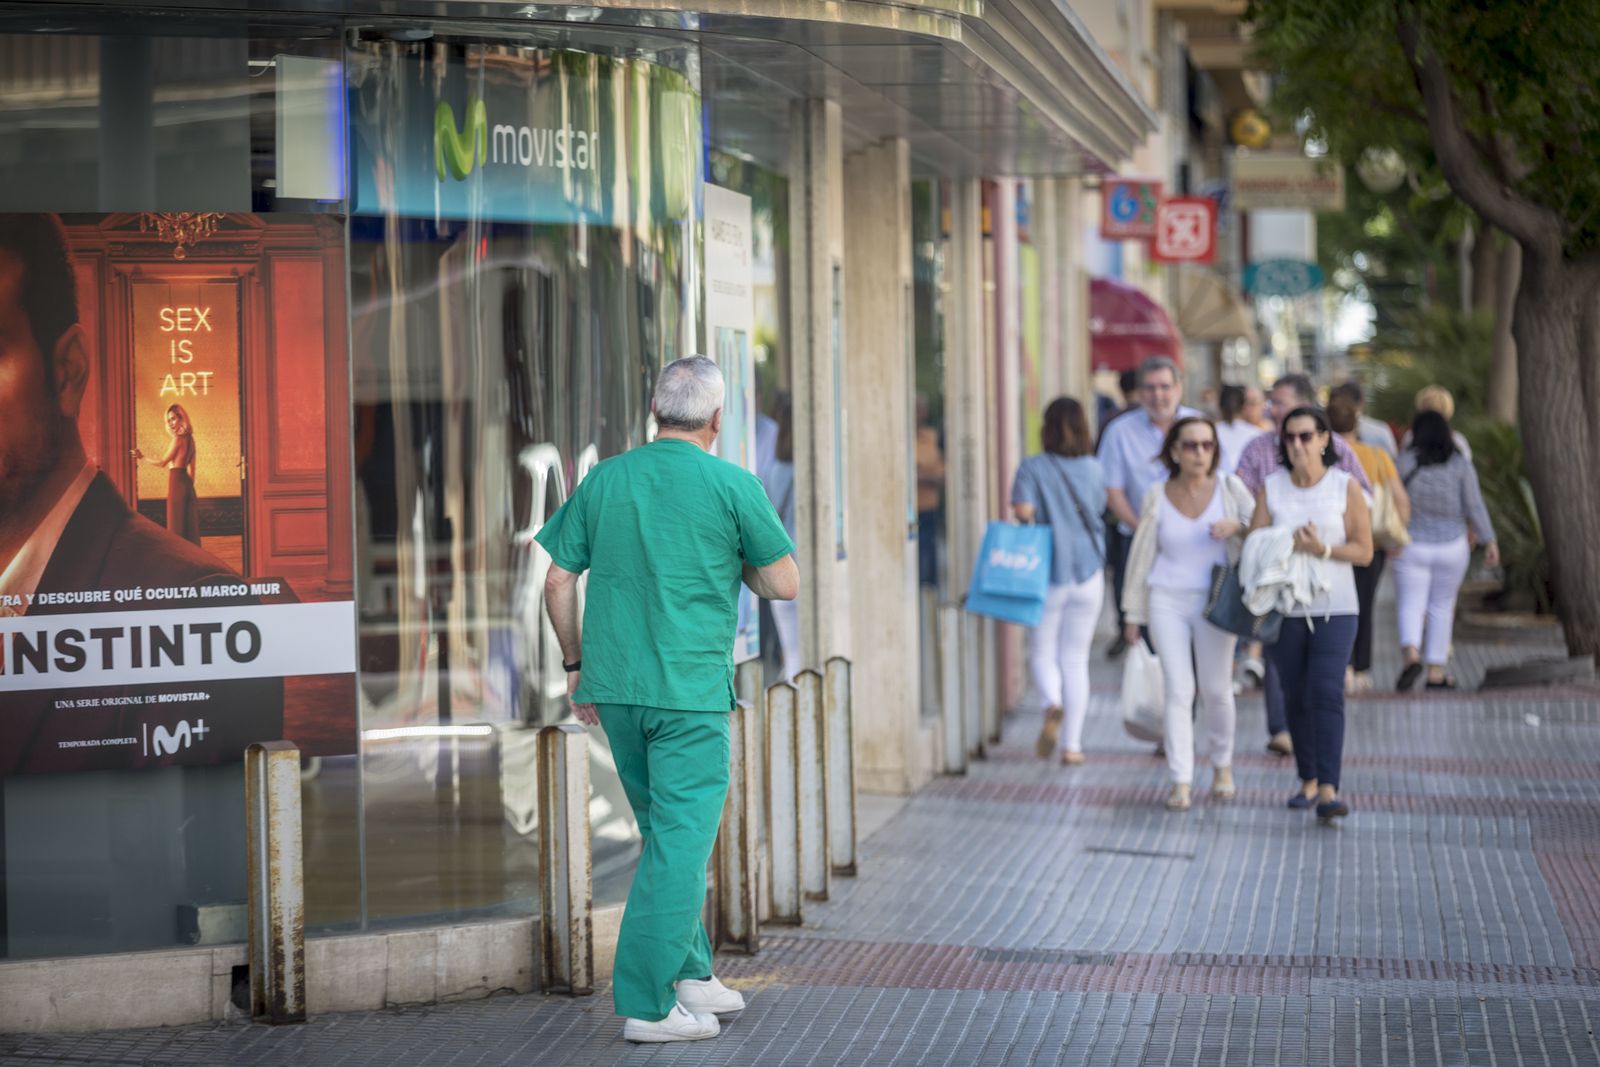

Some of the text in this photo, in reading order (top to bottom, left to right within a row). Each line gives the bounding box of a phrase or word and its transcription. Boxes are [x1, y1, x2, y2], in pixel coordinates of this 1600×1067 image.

[493, 124, 598, 170] movistar
[160, 307, 212, 332] SEX
[171, 339, 193, 364] IS
[160, 371, 214, 397] ART
[25, 593, 35, 605] Y
[38, 590, 112, 605] DESCUBRE
[113, 586, 143, 602] QUÉ
[145, 586, 198, 600] OCULTA
[200, 584, 248, 598] MARCO
[250, 582, 281, 595] MUR
[55, 691, 211, 709] UNA SERIE ORIGINAL DE MOVISTAR+
[58, 741, 101, 749] TEMPORADA
[101, 737, 138, 746] COMPLETA
